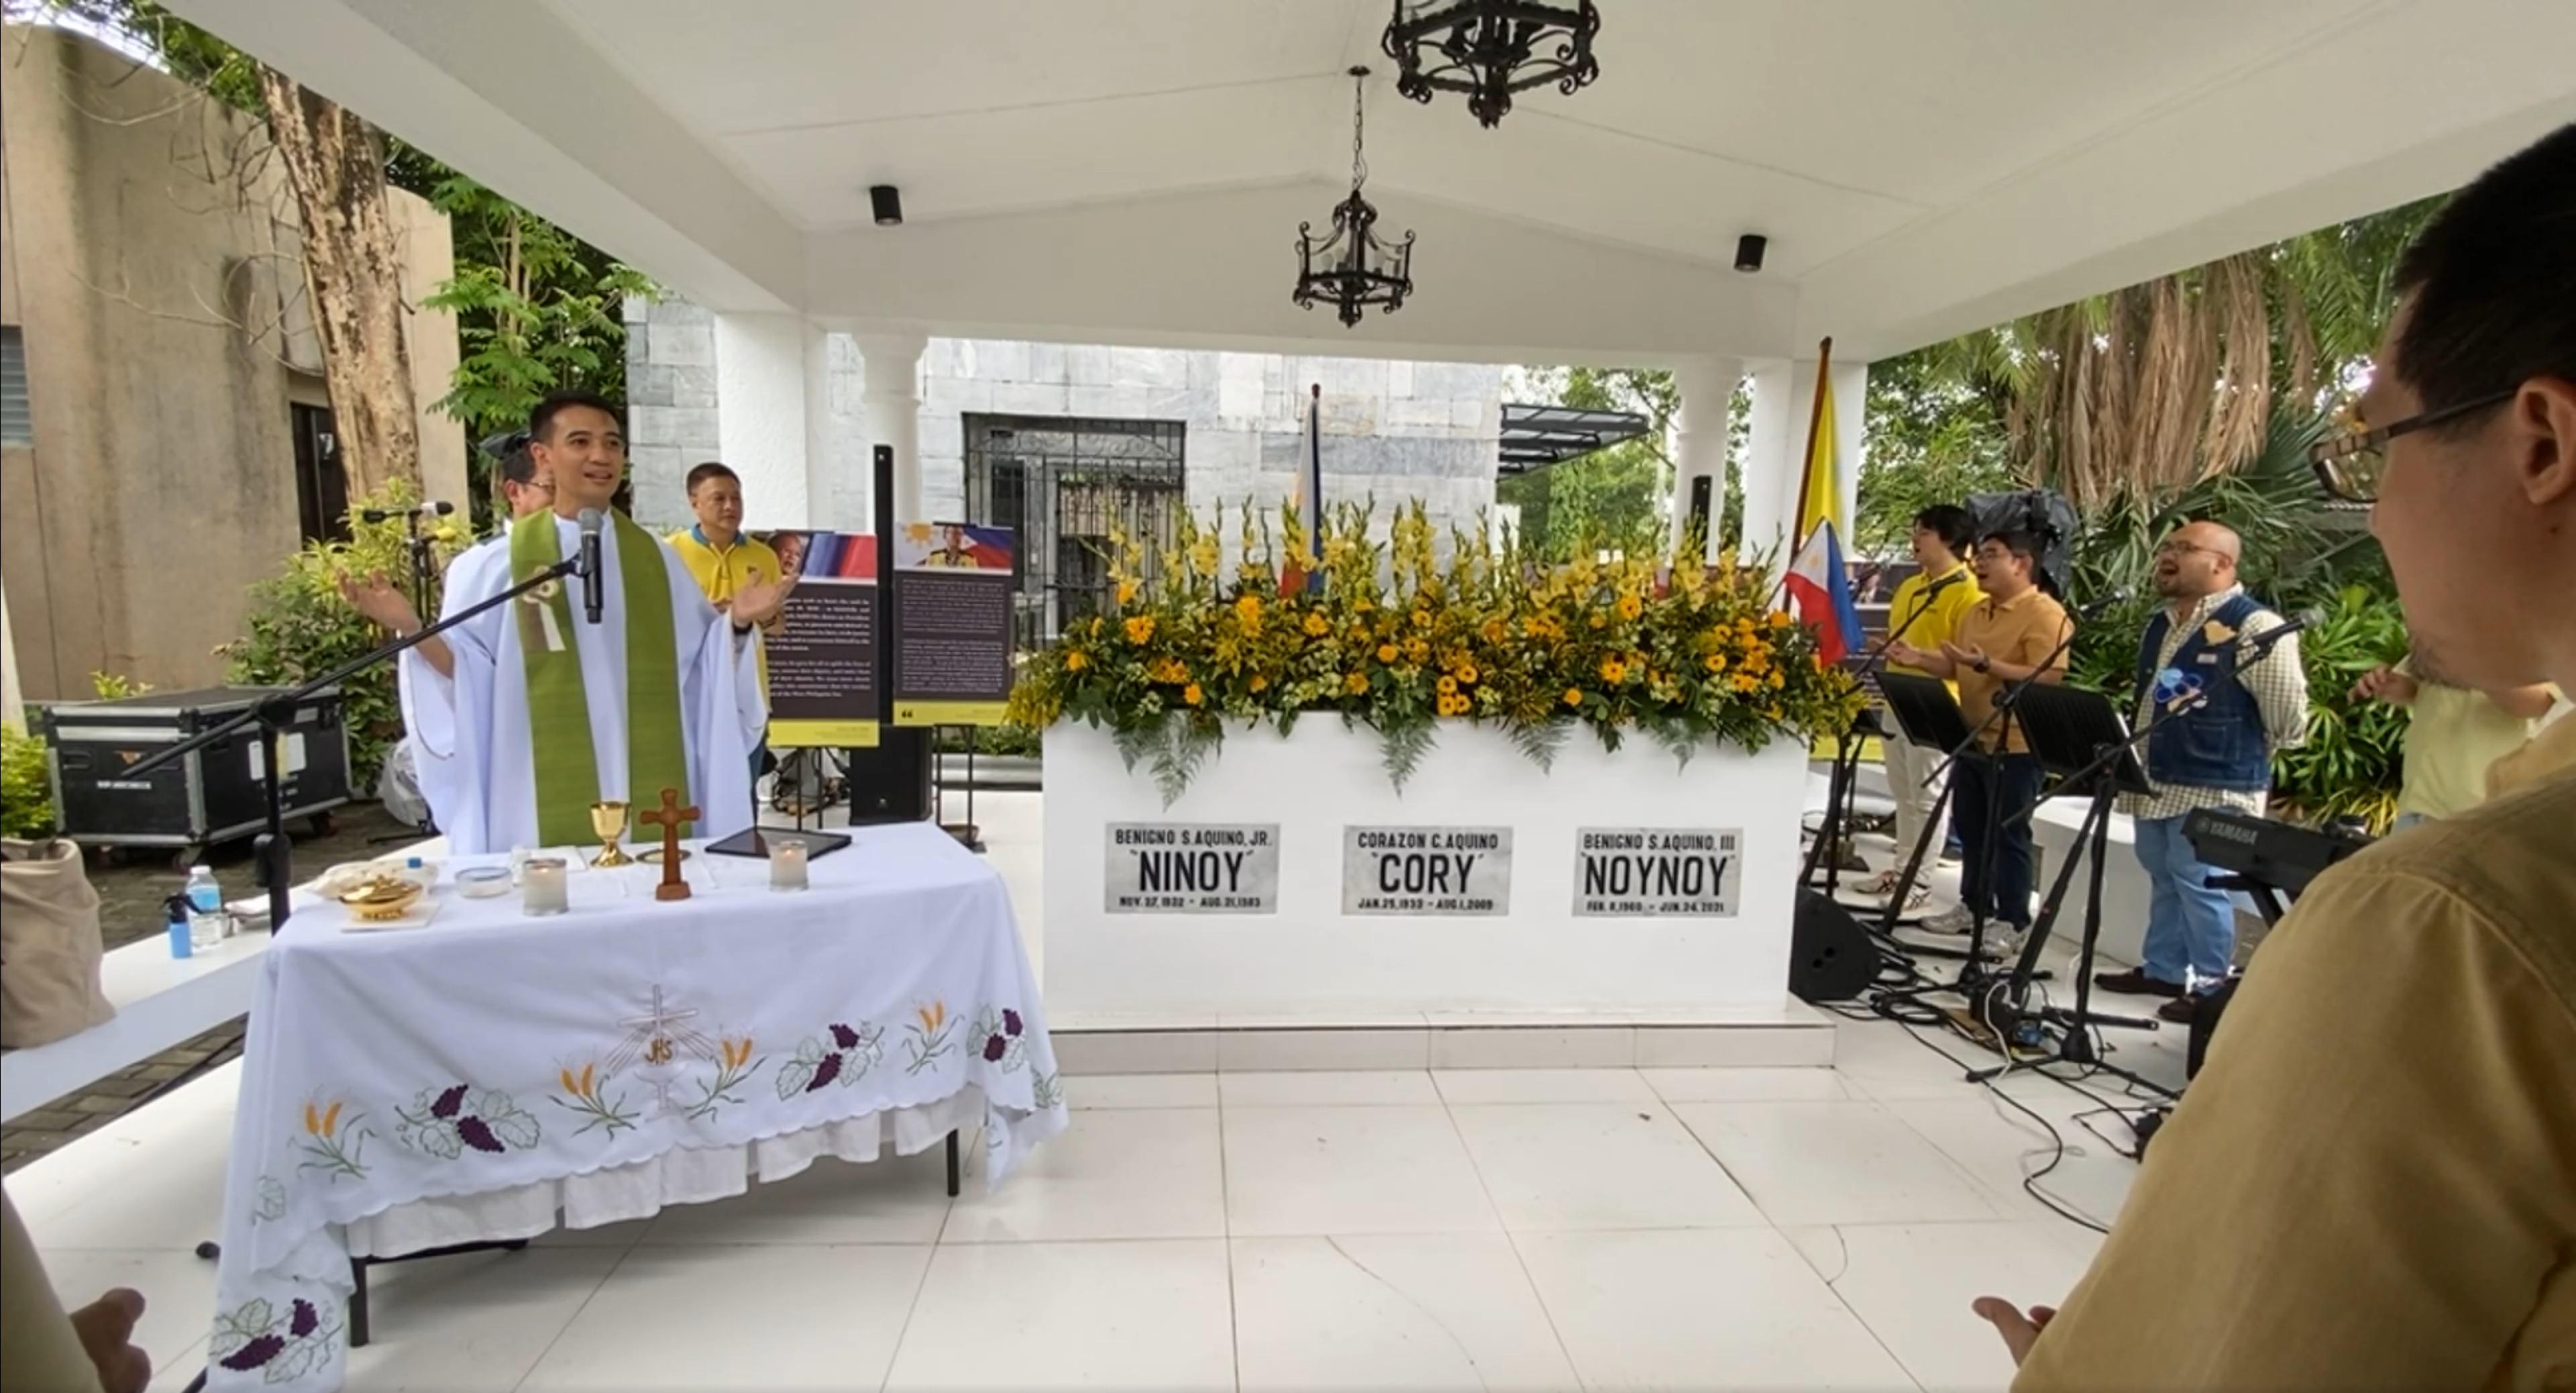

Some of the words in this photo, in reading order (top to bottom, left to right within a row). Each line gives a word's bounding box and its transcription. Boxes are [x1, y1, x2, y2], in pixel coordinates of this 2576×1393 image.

[1116, 829, 1175, 845] BENIGNO
[1357, 832, 1426, 849] CORAZON
[1583, 833, 1644, 849] BENIGNO
[1720, 835, 1735, 850] III
[2210, 821, 2259, 845] YAMAHA
